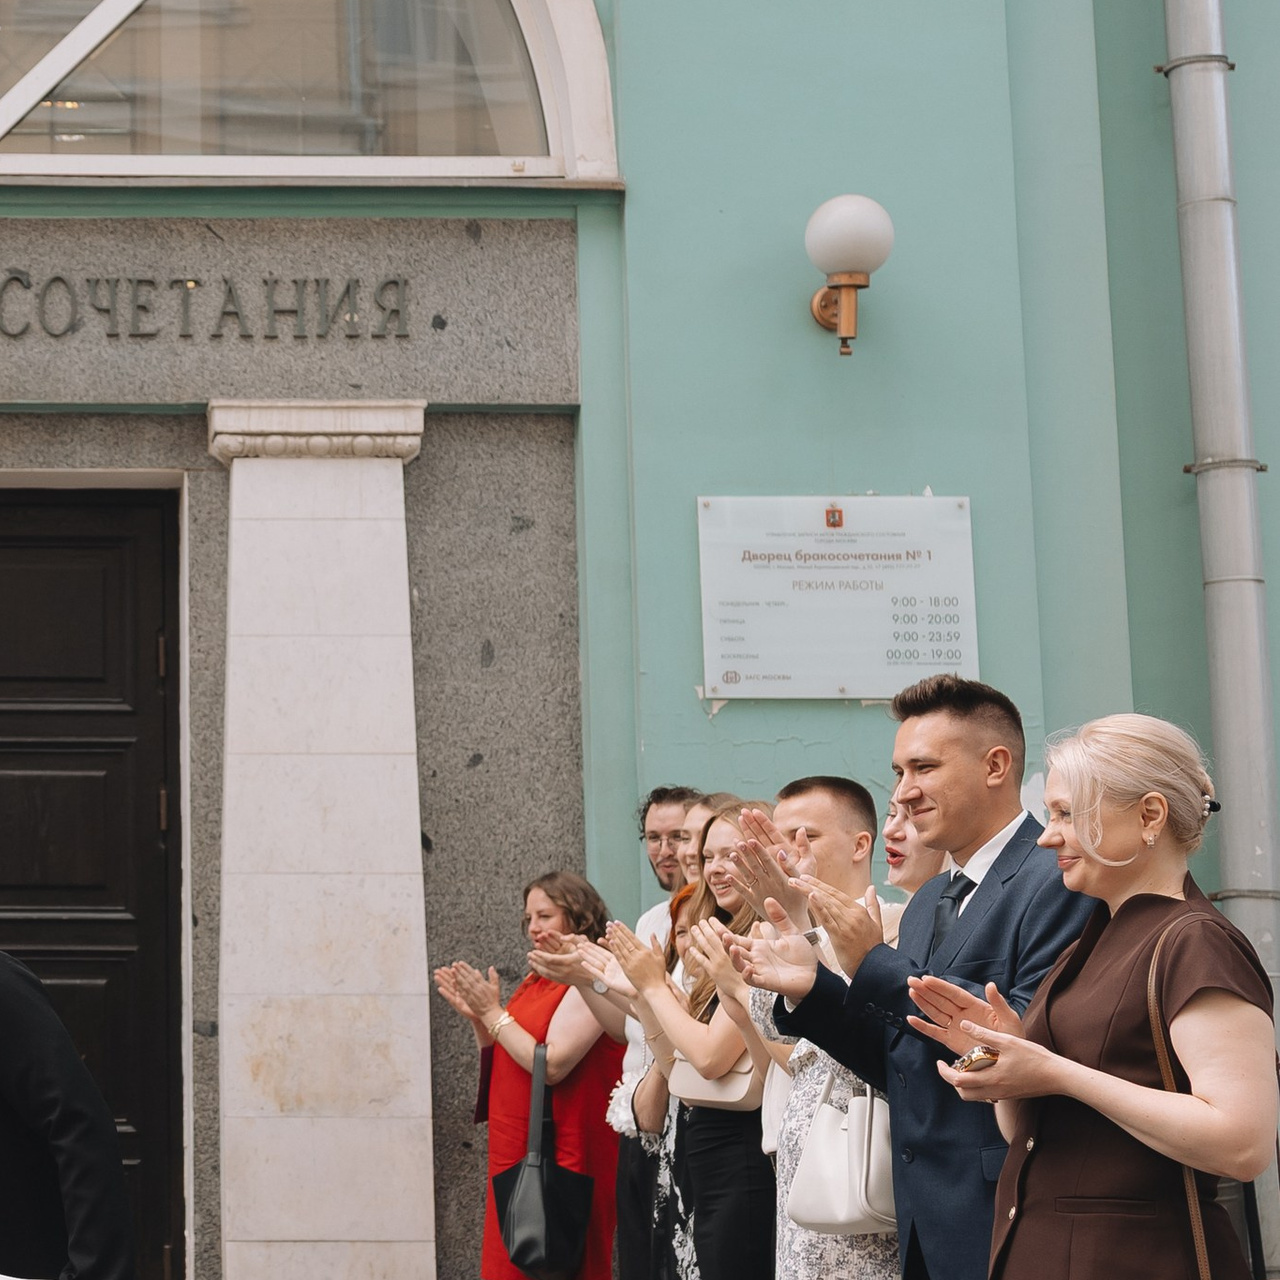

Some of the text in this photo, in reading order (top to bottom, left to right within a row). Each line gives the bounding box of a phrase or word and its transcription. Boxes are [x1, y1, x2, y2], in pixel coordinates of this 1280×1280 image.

[741, 549, 792, 564] Дворец
[795, 548, 902, 564] бракосочетания
[926, 549, 933, 561] 1
[791, 579, 884, 591] РЕЖИМ РАБОТЫ
[891, 596, 917, 607] 9:00
[929, 596, 959, 608] 18:00
[892, 613, 918, 625] 9:00
[927, 613, 960, 625] 20:00
[893, 631, 919, 642] 9:00
[928, 631, 961, 642] 23:59
[886, 648, 920, 660] 00:00
[930, 648, 962, 660] 19:00
